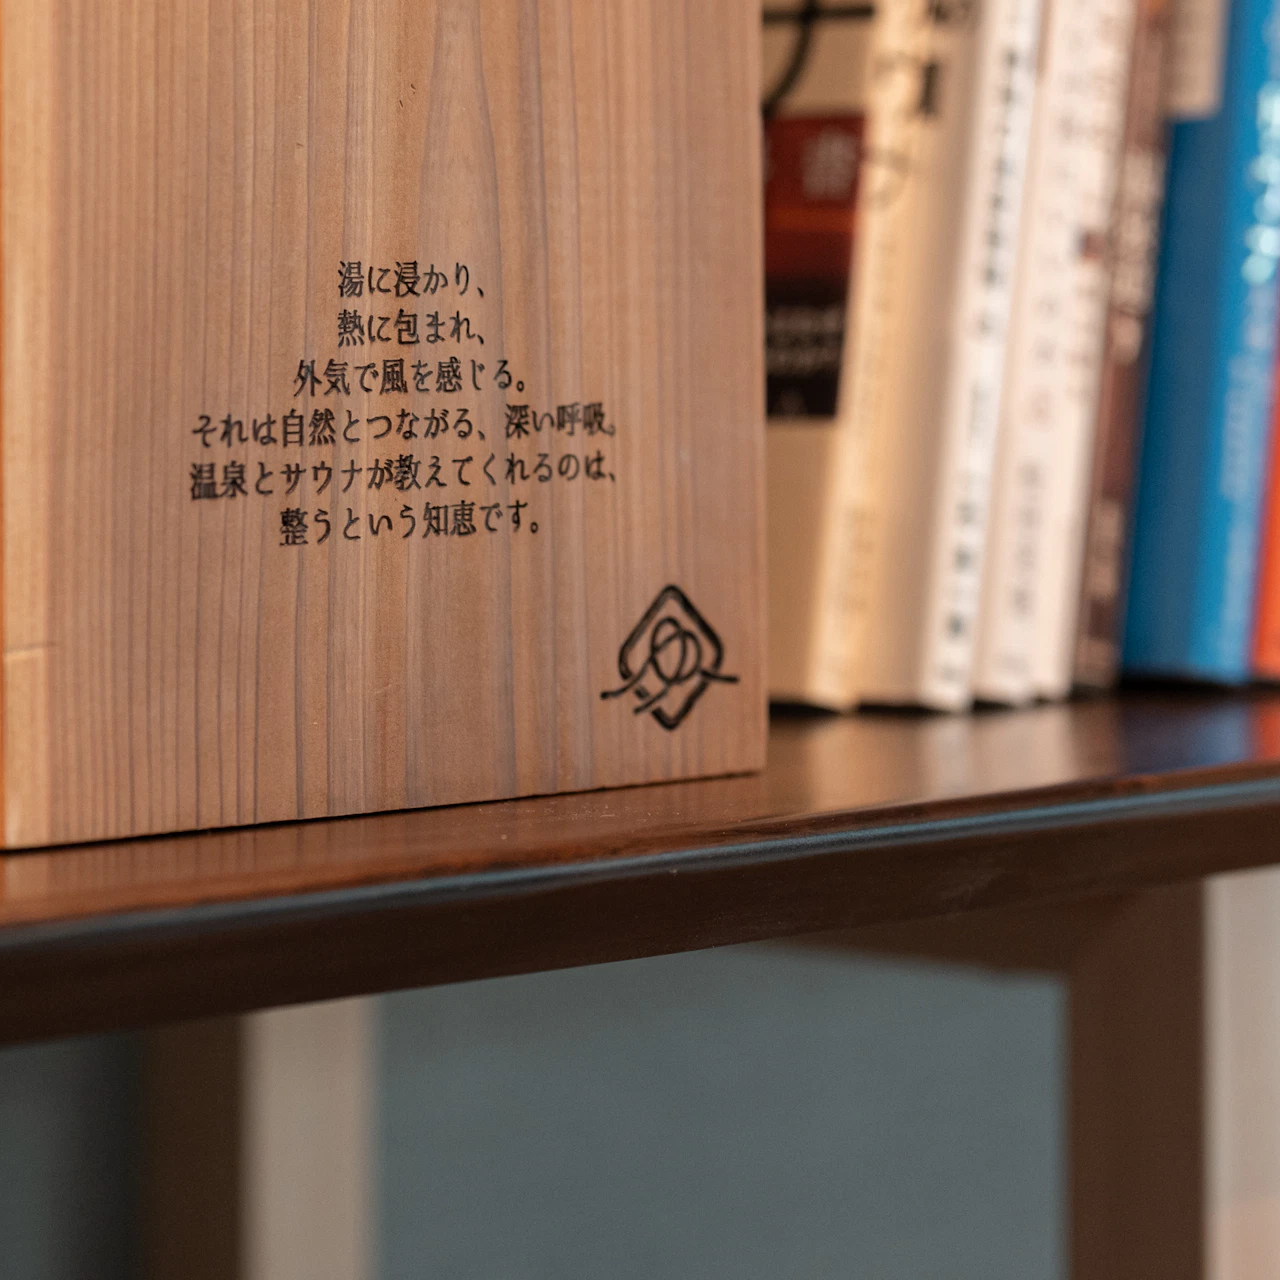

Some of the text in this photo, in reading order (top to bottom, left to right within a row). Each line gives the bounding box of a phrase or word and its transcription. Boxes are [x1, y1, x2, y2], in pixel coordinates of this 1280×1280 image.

[337, 260, 486, 298] 湯に浸かり、
[337, 308, 486, 348] 熱に包まれ、
[293, 356, 526, 397] 外気で風を感じる。
[189, 450, 617, 501] 温泉とサウナが教えてくれるのは、
[278, 499, 540, 547] 整うという知恵です。
